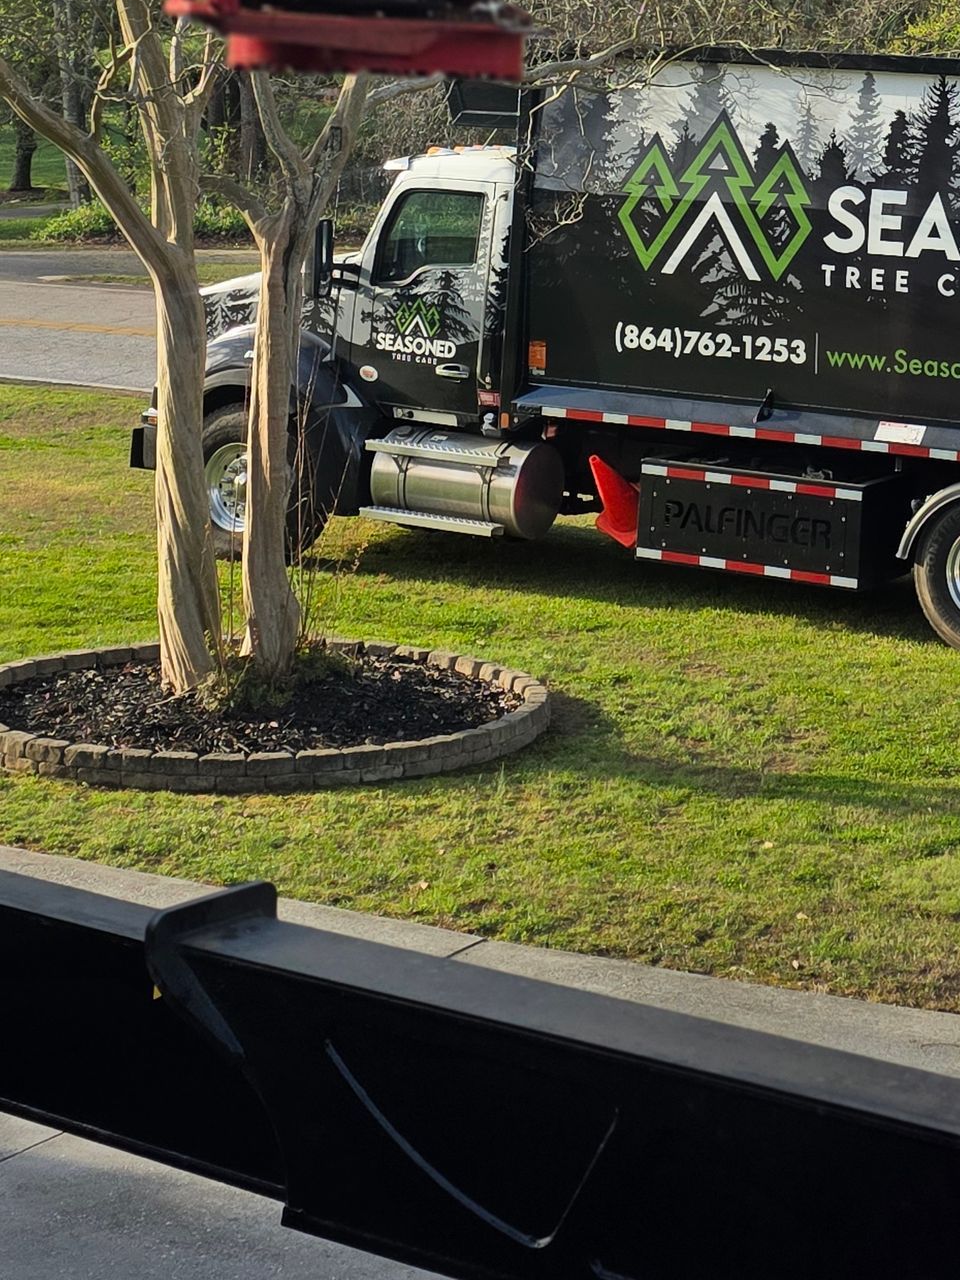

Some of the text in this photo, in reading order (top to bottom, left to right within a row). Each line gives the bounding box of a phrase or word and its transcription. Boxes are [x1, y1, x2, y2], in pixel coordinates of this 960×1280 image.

[821, 264, 910, 294] TREE
[375, 332, 457, 359] SEASONED
[614, 322, 807, 365] (864)762-1253
[664, 500, 832, 550] PALFINGER
